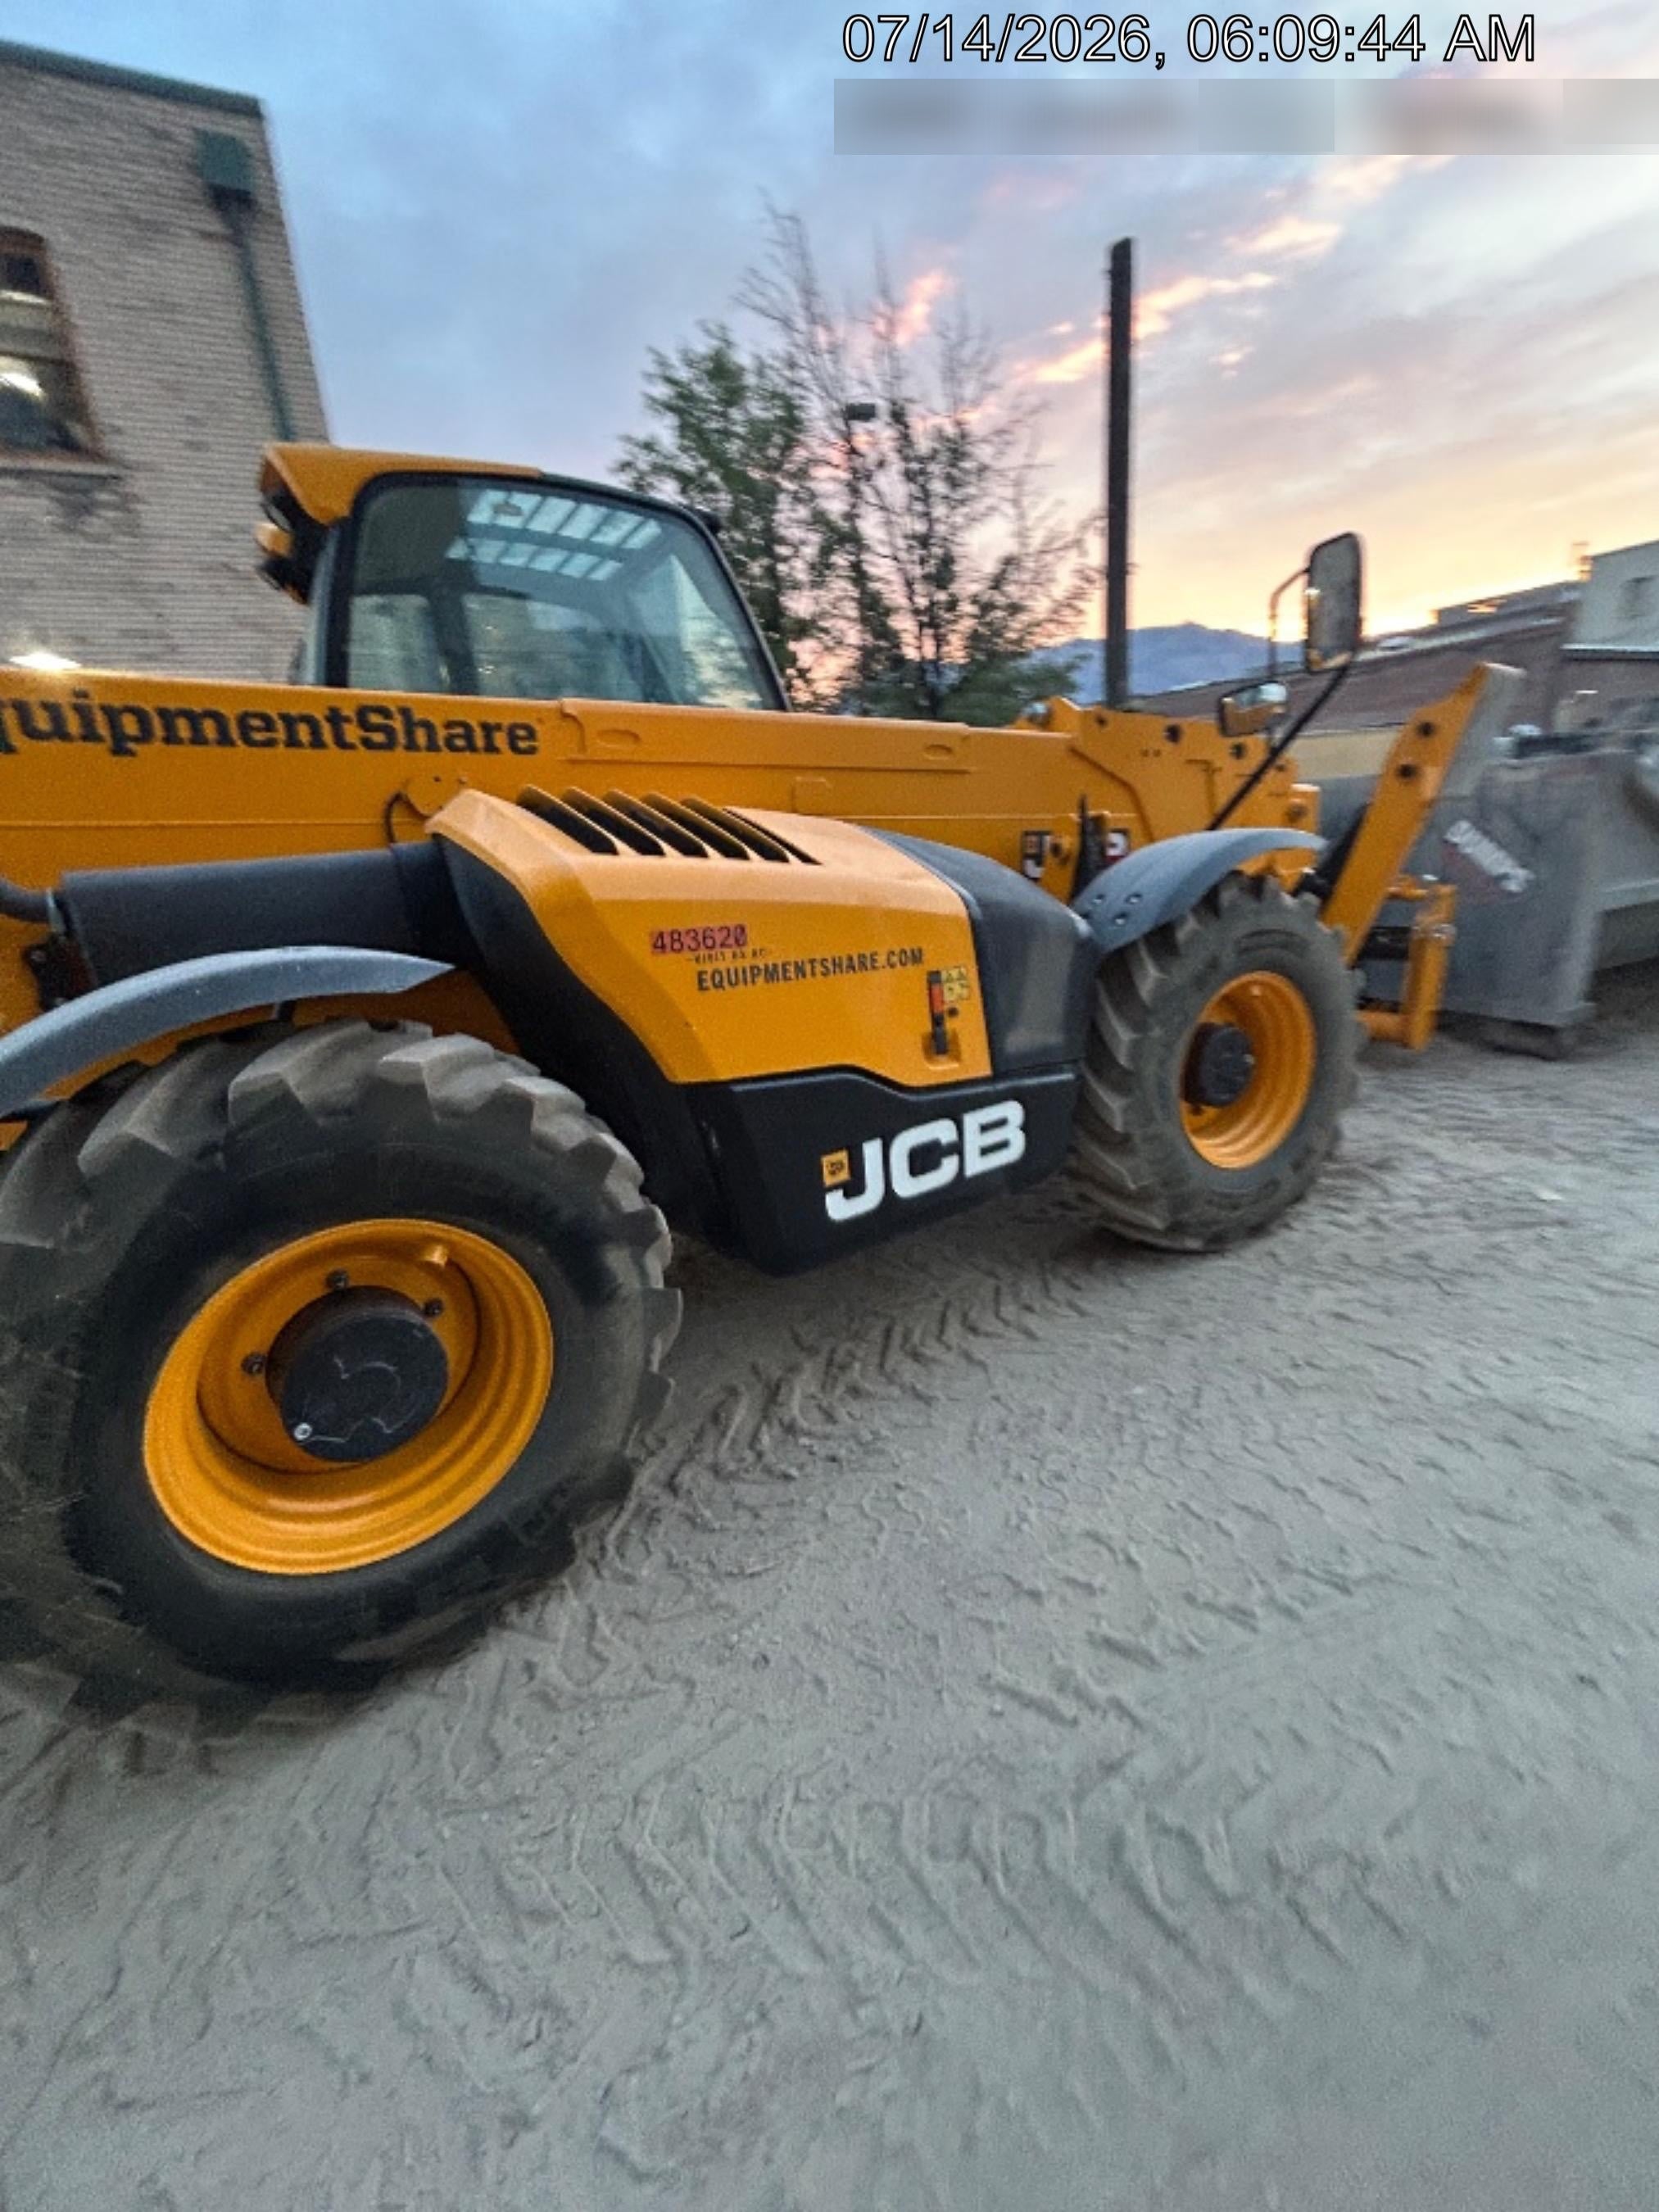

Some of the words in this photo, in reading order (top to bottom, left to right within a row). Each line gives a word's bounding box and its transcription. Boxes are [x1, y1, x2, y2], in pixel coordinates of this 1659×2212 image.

[0, 689, 538, 756] uipmentShare
[652, 923, 746, 954] 483620
[696, 945, 923, 991] EQUIPMENTSHARE.COM
[824, 1099, 1026, 1222] JCB
